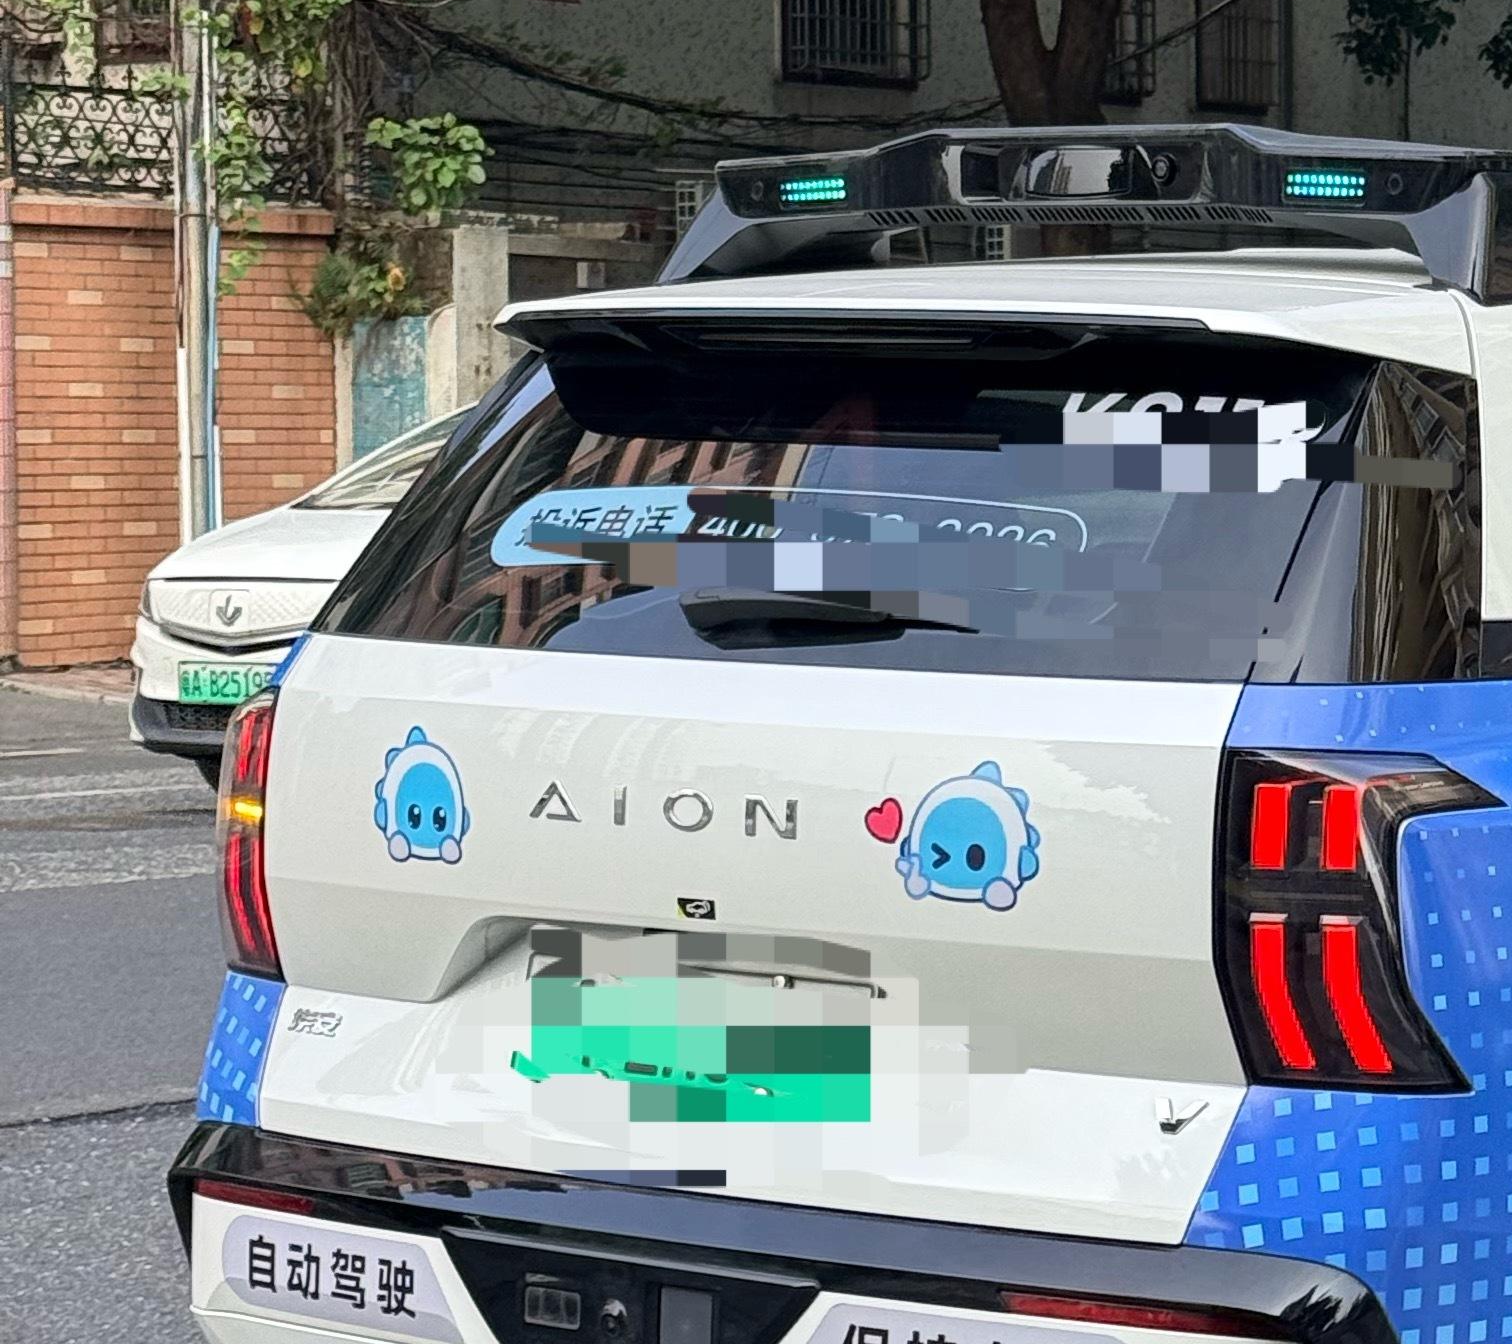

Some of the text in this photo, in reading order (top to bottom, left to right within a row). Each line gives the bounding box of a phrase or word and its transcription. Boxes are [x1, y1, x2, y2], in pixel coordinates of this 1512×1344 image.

[529, 778, 798, 841] AION
[246, 1234, 417, 1320] 自动驾驶
